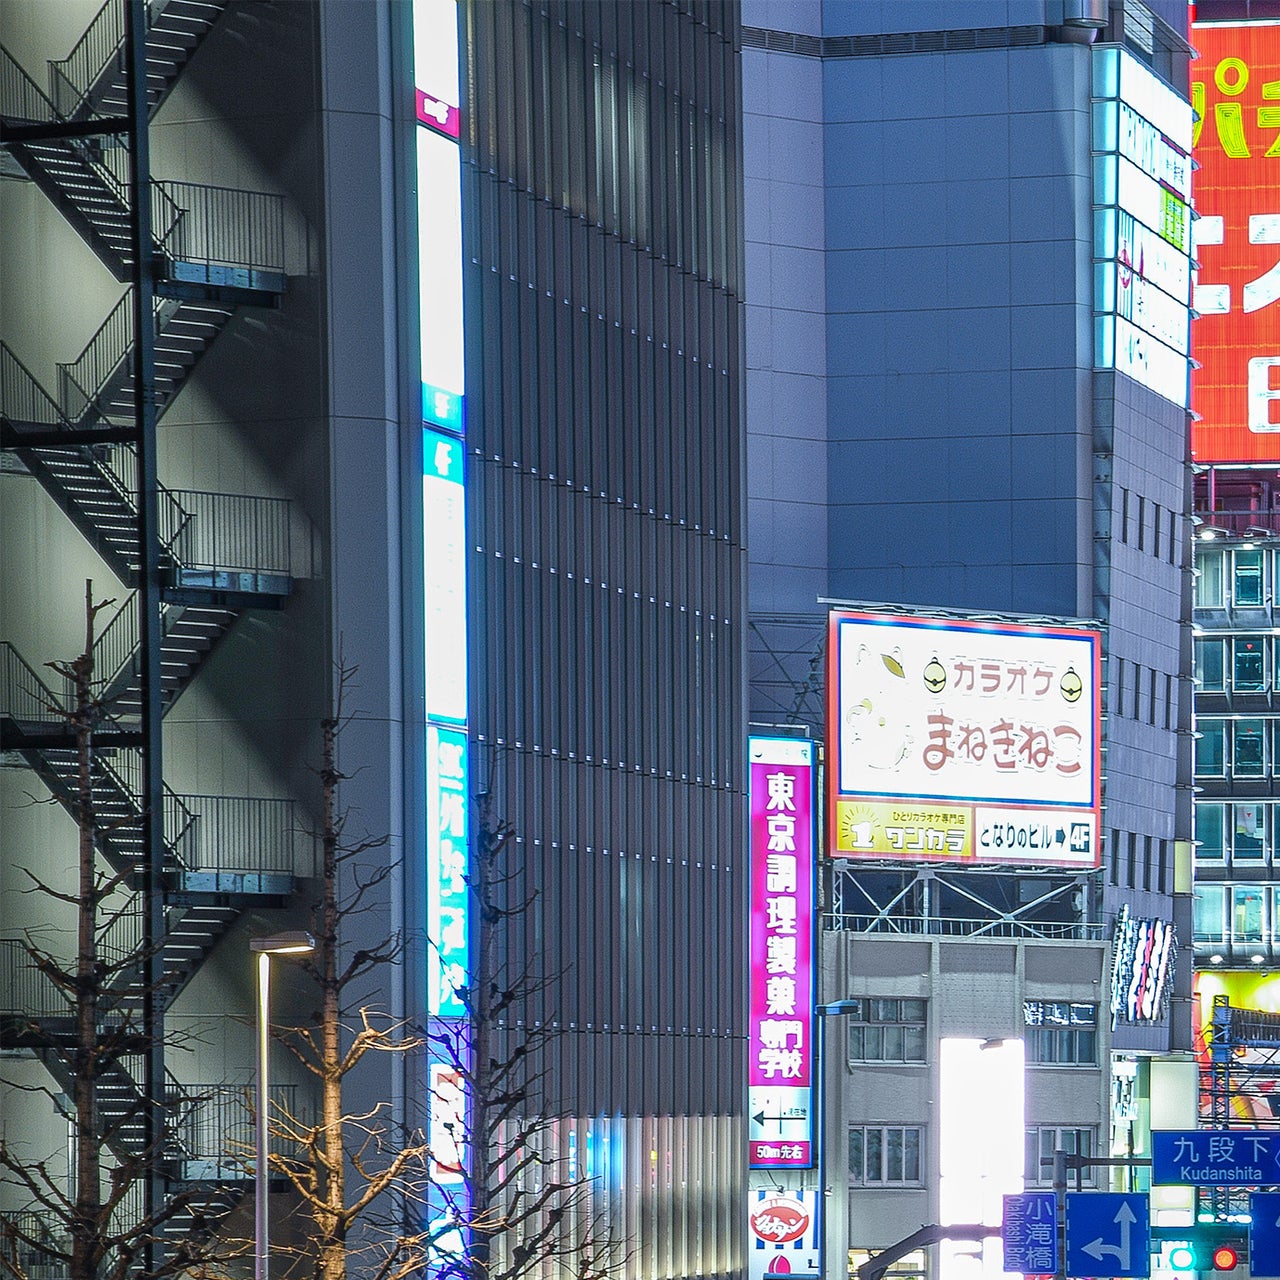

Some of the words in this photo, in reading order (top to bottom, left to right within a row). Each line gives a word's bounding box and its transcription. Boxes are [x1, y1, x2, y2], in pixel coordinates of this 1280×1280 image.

[952, 659, 1055, 696] カラオケ
[922, 710, 1083, 772] まねきねこ
[884, 826, 966, 853] ワンカラ
[1173, 1136, 1270, 1164] 九段下
[1180, 1167, 1262, 1181] Kudanshita
[1025, 1197, 1052, 1270] 小滝橋
